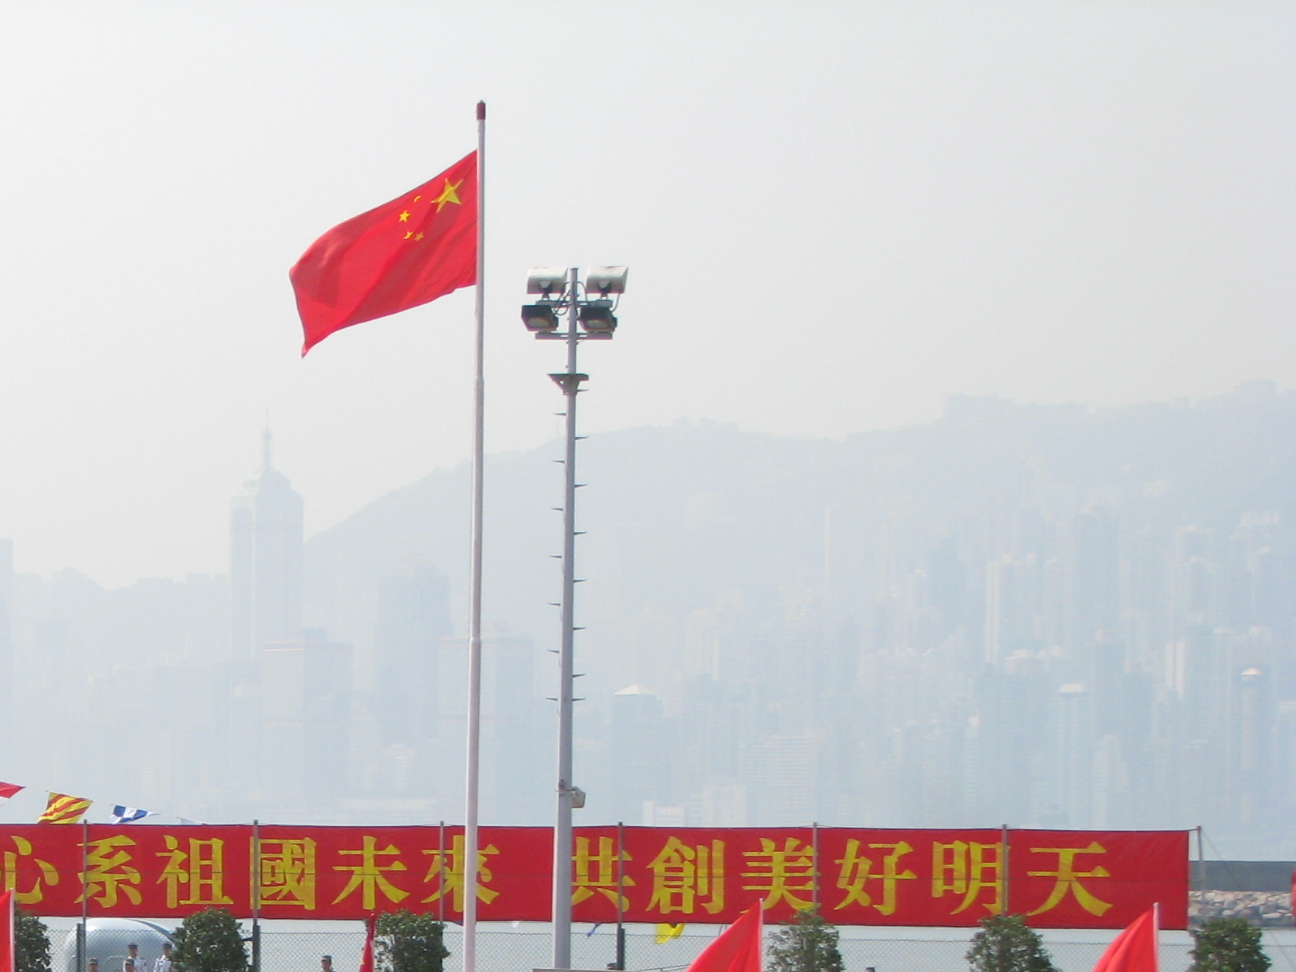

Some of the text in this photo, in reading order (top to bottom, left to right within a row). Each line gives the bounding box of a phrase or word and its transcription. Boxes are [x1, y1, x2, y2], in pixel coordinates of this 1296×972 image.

[569, 835, 1113, 917] 共創美好明天
